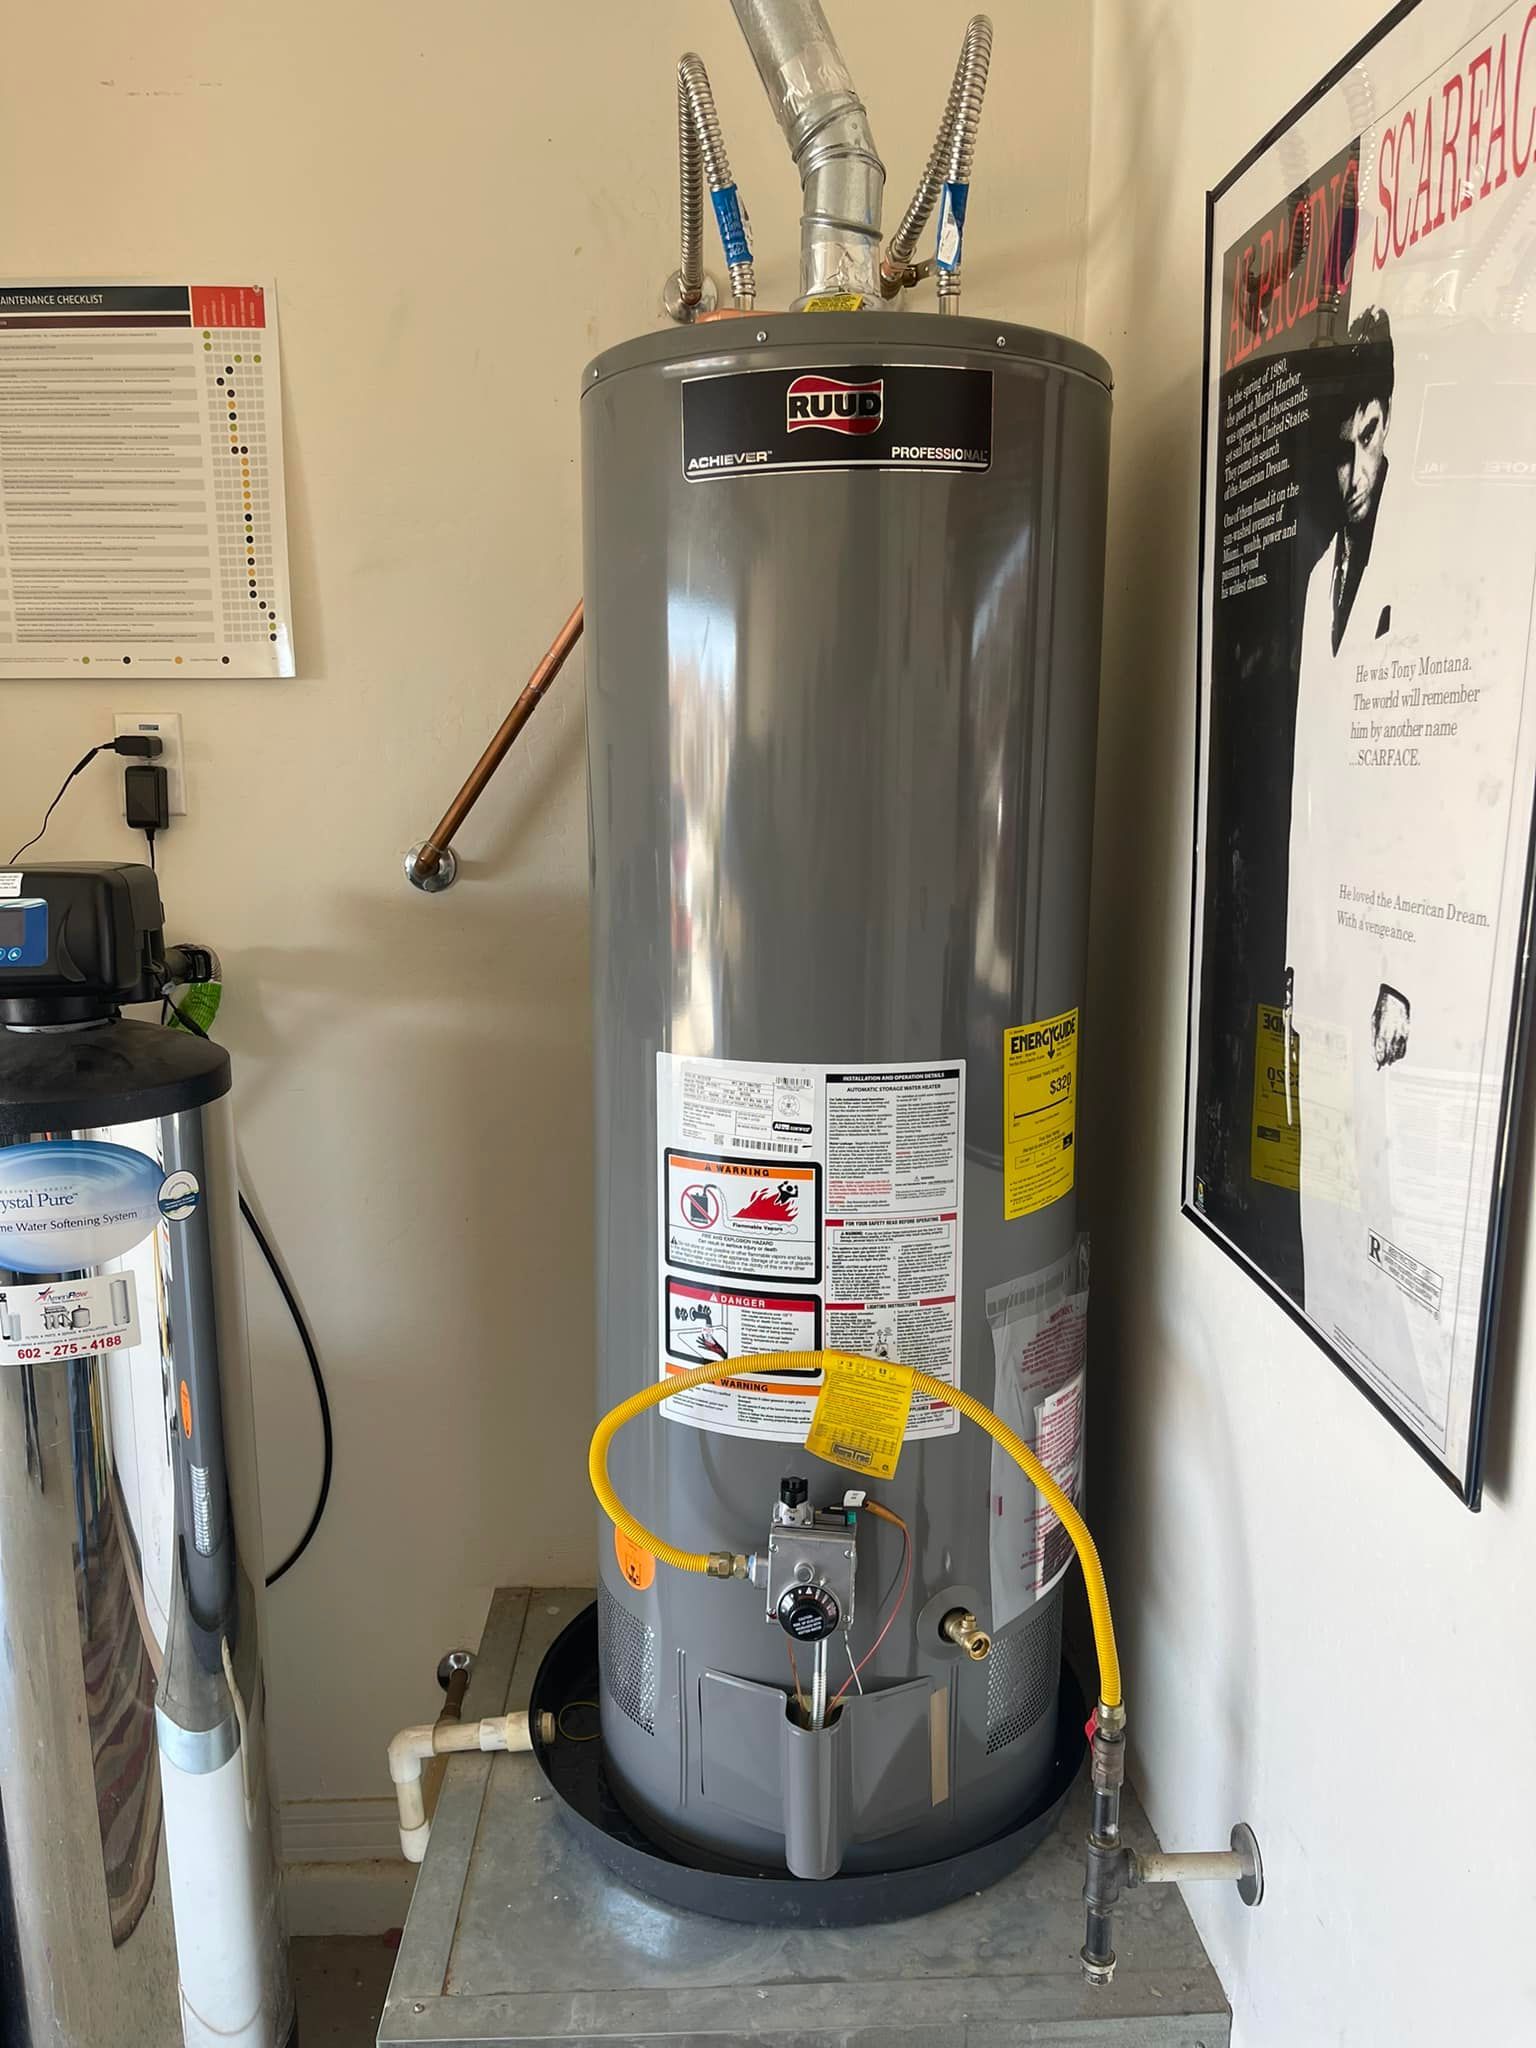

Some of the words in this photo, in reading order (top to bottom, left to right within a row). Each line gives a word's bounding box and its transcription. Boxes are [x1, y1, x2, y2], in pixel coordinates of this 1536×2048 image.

[1372, 4, 1536, 272] SCARFAC
[1225, 247, 1253, 371] AL
[1253, 159, 1360, 350] PACINO
[57, 294, 103, 304] CHECKLIST
[1234, 389, 1243, 405] the
[1244, 377, 1261, 400] spring
[1262, 366, 1270, 385] of
[788, 393, 882, 419] RUUD
[1226, 412, 1235, 428] the
[1236, 405, 1247, 426] port
[1254, 383, 1274, 410] Mariel
[1275, 372, 1301, 396] Harbor
[1258, 404, 1270, 425] and
[1271, 385, 1308, 418] thousands
[1242, 438, 1251, 454] for
[1252, 432, 1262, 449] the
[1262, 415, 1284, 442] United
[1285, 408, 1310, 430] States.
[1259, 439, 1280, 461] search
[1266, 458, 1290, 479] Dream.
[1253, 491, 1270, 513] found
[1276, 490, 1286, 502] on
[1286, 482, 1300, 498] the
[1276, 504, 1284, 522] of
[1262, 530, 1282, 550] power
[1282, 519, 1296, 540] and
[1356, 665, 1369, 683] He
[1370, 666, 1388, 681] was
[1391, 660, 1417, 682] Tony
[1418, 656, 1472, 676] Montana.
[1353, 693, 1370, 711] The
[1372, 690, 1399, 710] world
[1401, 688, 1420, 708] will
[1422, 684, 1480, 706] remember
[1351, 722, 1368, 739] him
[1370, 720, 1383, 742] by
[1384, 718, 1424, 739] another
[1425, 722, 1458, 737] name
[1339, 884, 1352, 900] He
[1352, 886, 1376, 905] loved
[1376, 890, 1392, 907] the
[1393, 896, 1445, 919] American
[1446, 903, 1490, 927] Dream.
[1337, 910, 1358, 929] With
[1358, 918, 1364, 930] a
[1364, 918, 1416, 943] vengeance.
[716, 1164, 770, 1177] WARNING
[16, 1222, 47, 1232] Water
[50, 1217, 100, 1230] Softening
[103, 1210, 138, 1226] System
[732, 1222, 762, 1231] Flammable
[916, 1216, 939, 1224] OPERATING
[1369, 1235, 1382, 1264] R
[720, 1295, 766, 1308] DANGER
[888, 1302, 918, 1310] INSTRUCTIONS
[17, 1348, 41, 1360] 602
[54, 1343, 78, 1356] 275
[90, 1336, 122, 1350] 4188
[720, 1378, 768, 1392] WARNING
